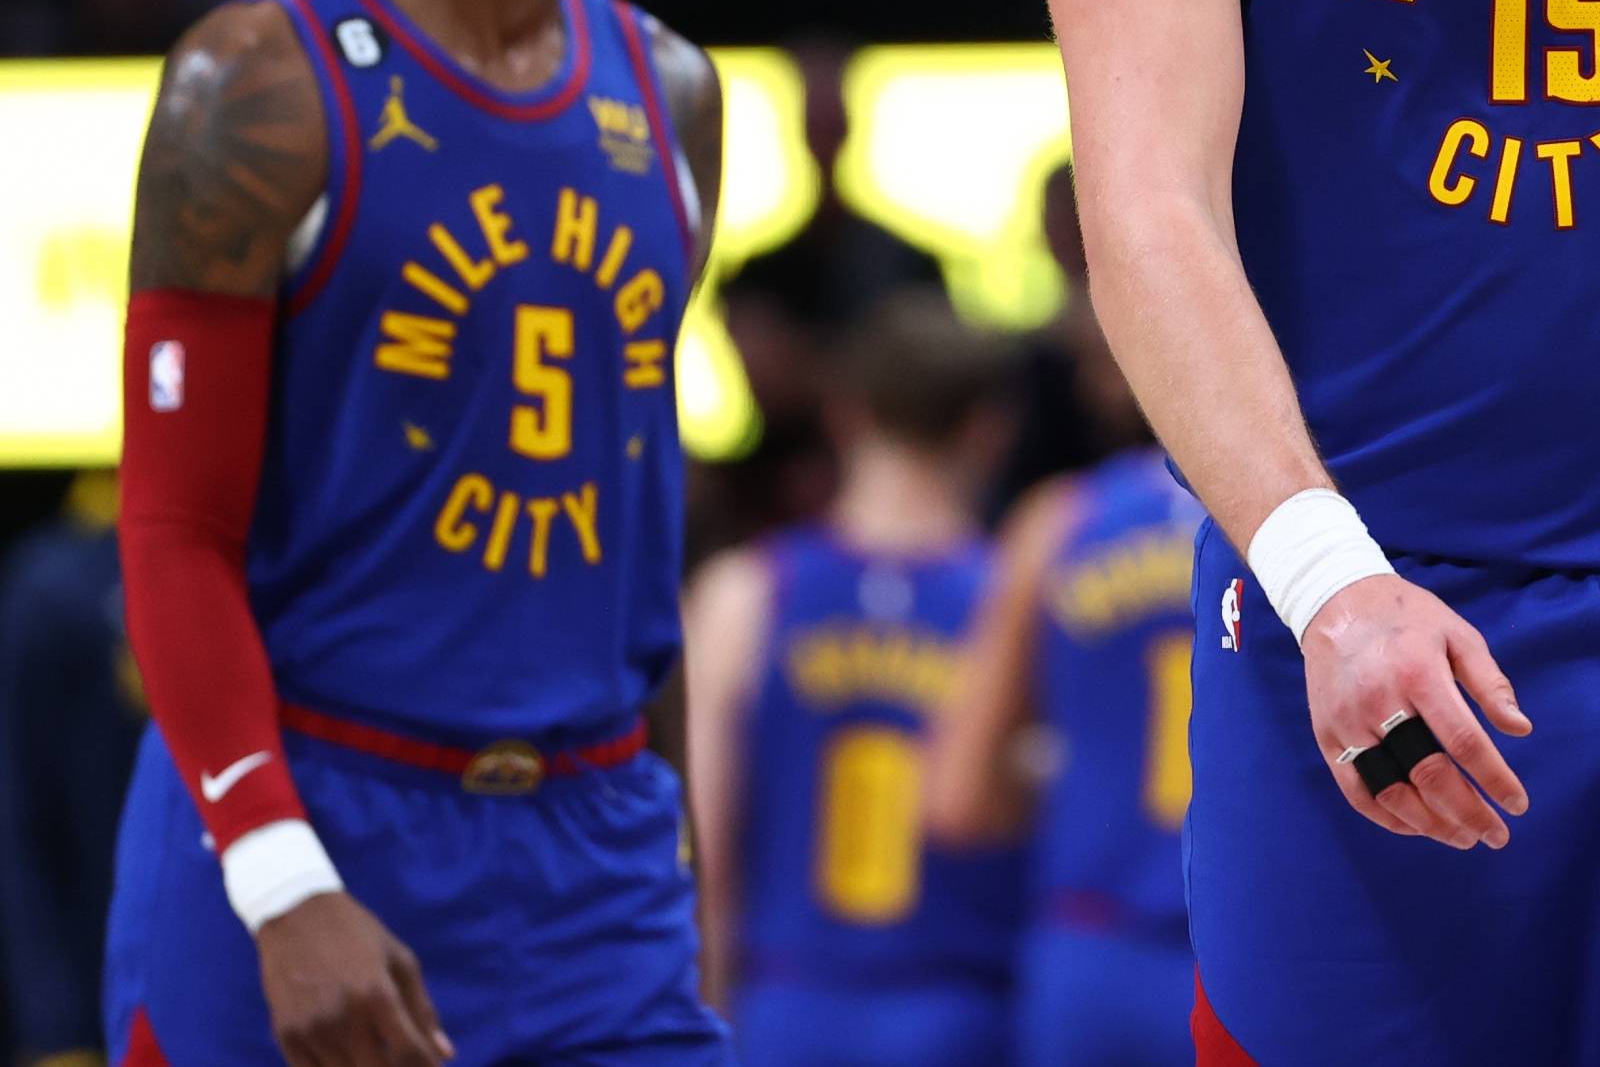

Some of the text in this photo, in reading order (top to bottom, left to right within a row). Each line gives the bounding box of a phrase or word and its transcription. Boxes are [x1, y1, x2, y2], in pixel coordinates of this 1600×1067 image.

[336, 18, 382, 68] 6
[374, 183, 668, 390] MILE HIGH
[510, 304, 575, 461] 5
[434, 472, 602, 577] CITY
